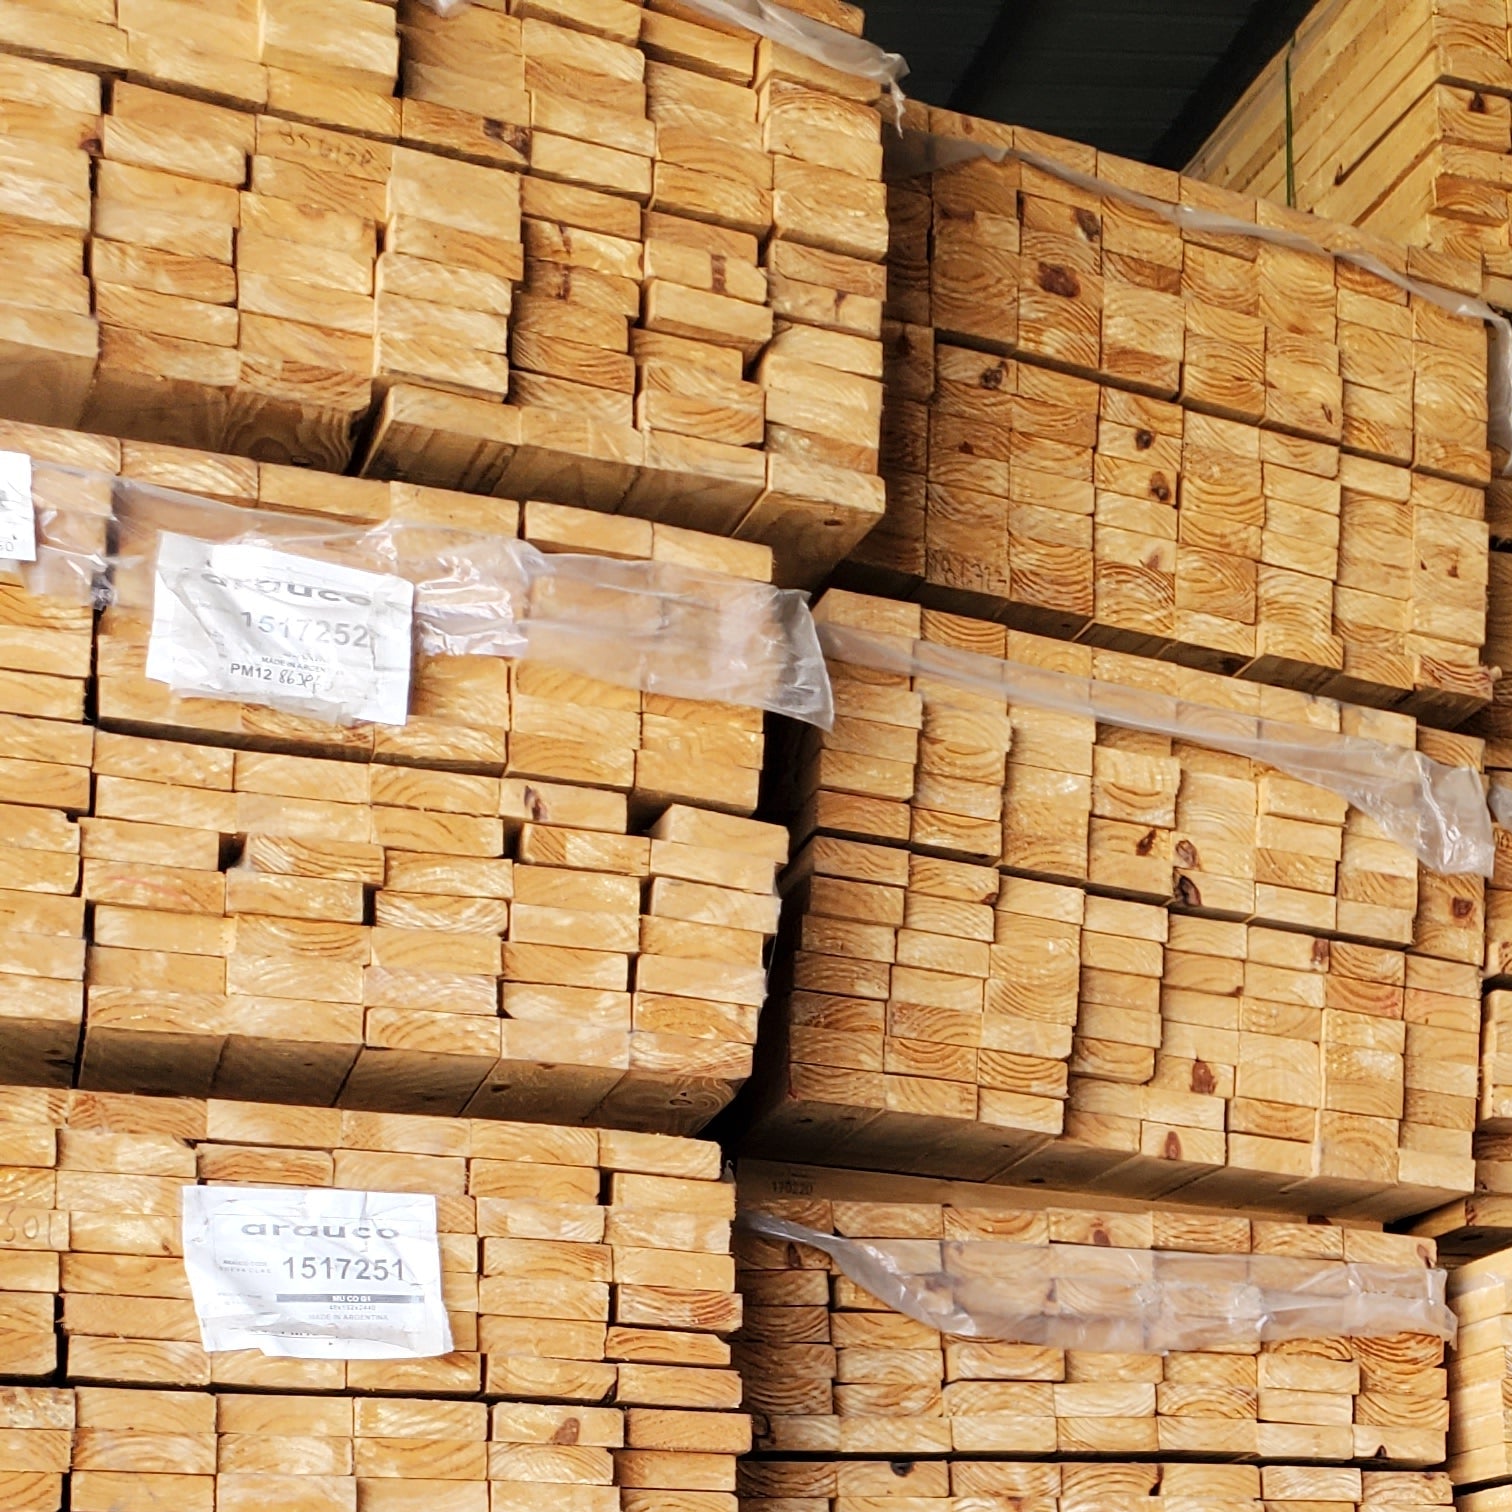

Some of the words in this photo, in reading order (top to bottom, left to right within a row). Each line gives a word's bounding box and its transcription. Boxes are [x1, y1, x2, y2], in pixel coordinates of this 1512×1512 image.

[240, 611, 371, 649] 1517252
[230, 663, 273, 681] PM12
[241, 1222, 400, 1240] arauco
[282, 1256, 404, 1282] 1517251
